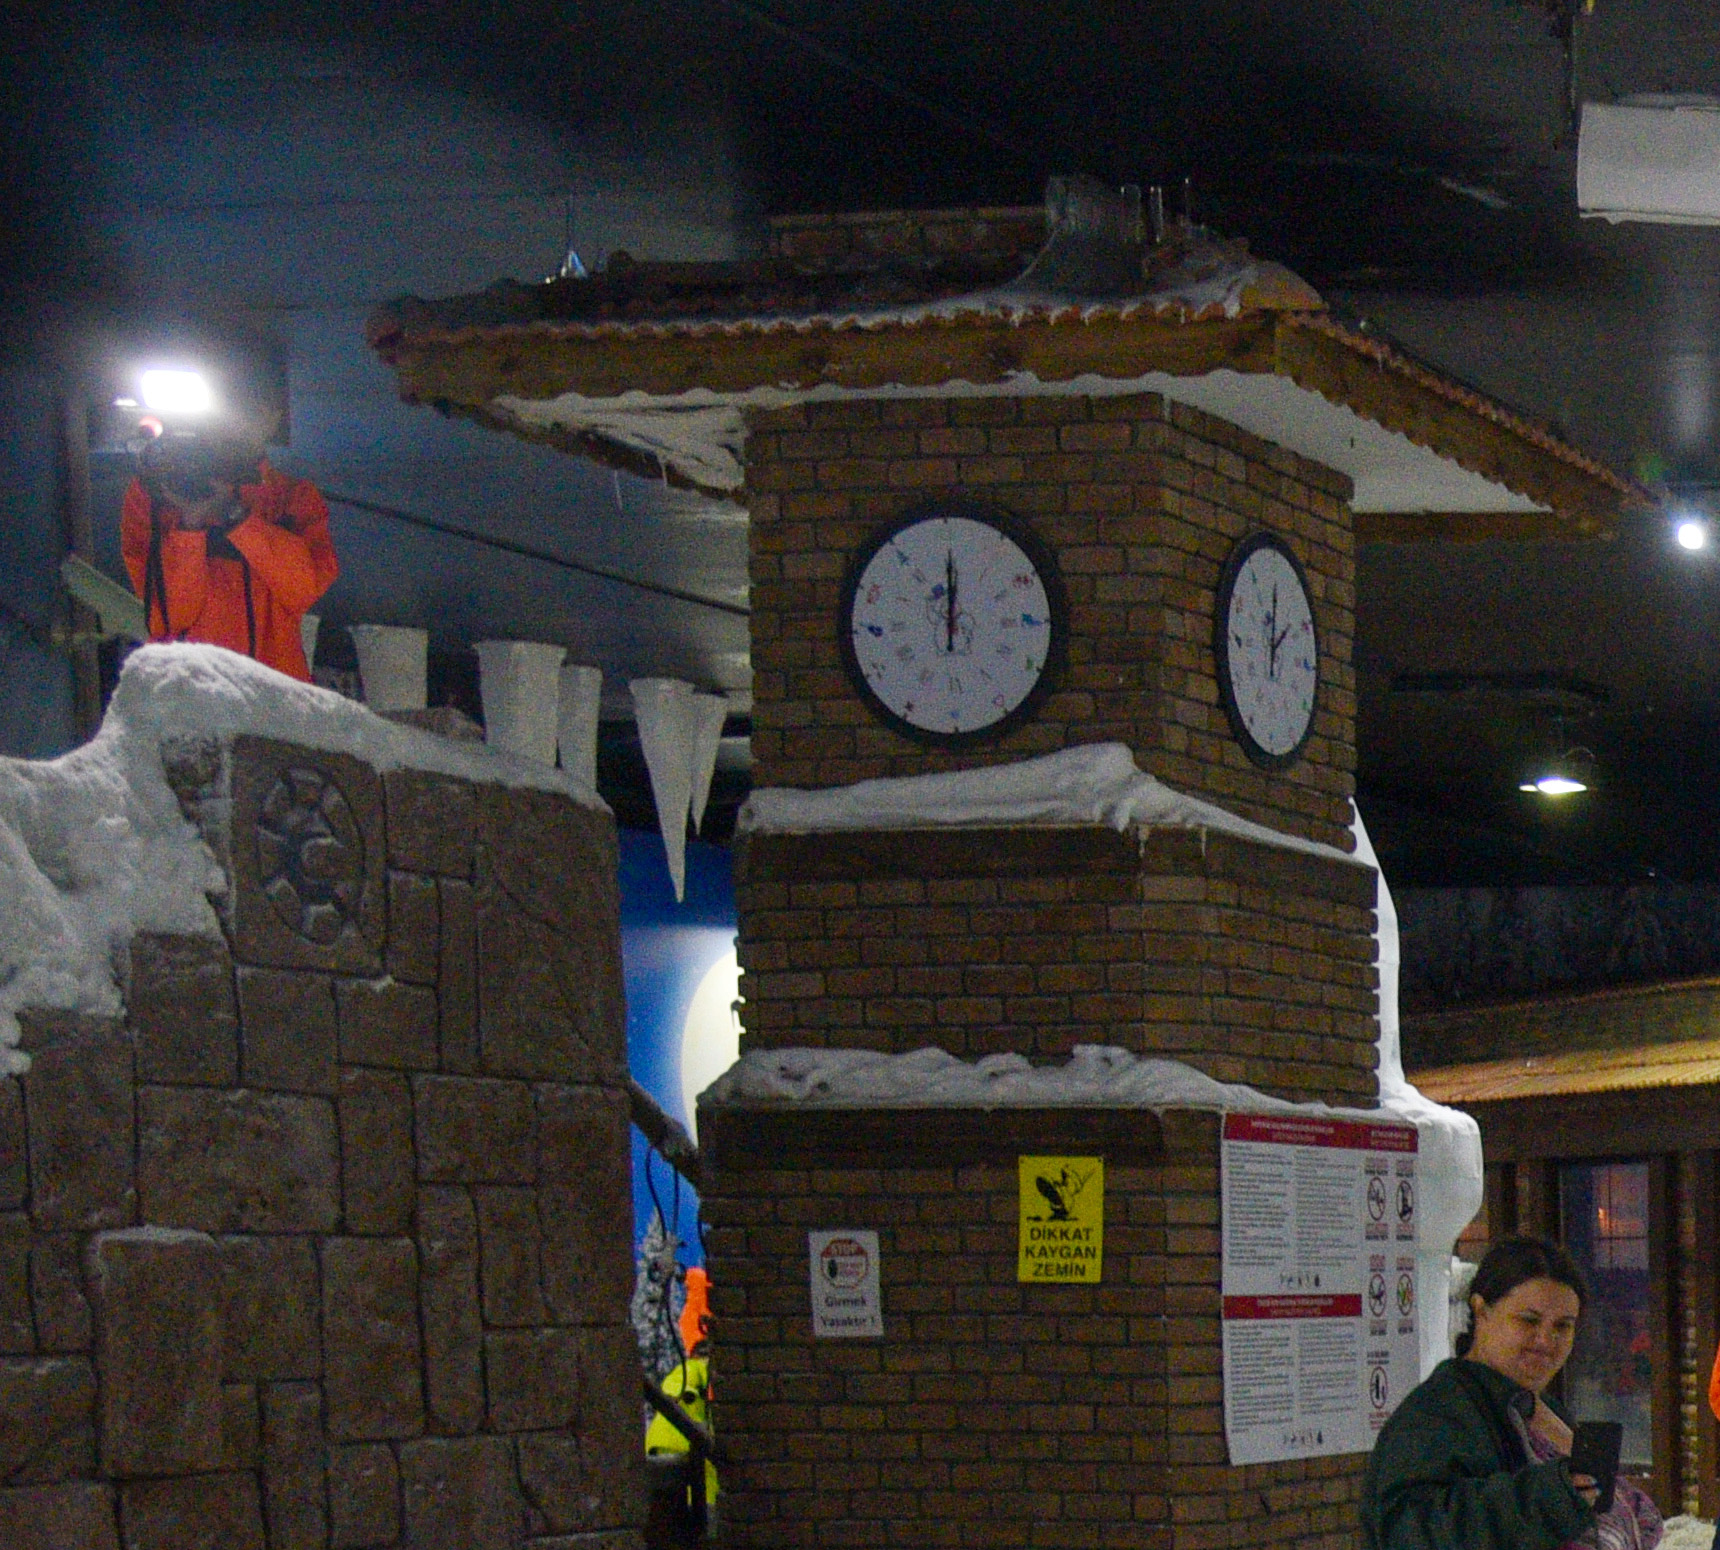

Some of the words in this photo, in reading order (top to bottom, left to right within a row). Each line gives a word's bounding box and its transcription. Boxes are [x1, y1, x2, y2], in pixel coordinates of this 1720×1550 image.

[1030, 1225, 1094, 1241] DİKKAT
[1024, 1245, 1097, 1259] KAYGAN
[1033, 1262, 1087, 1277] ZEMİN
